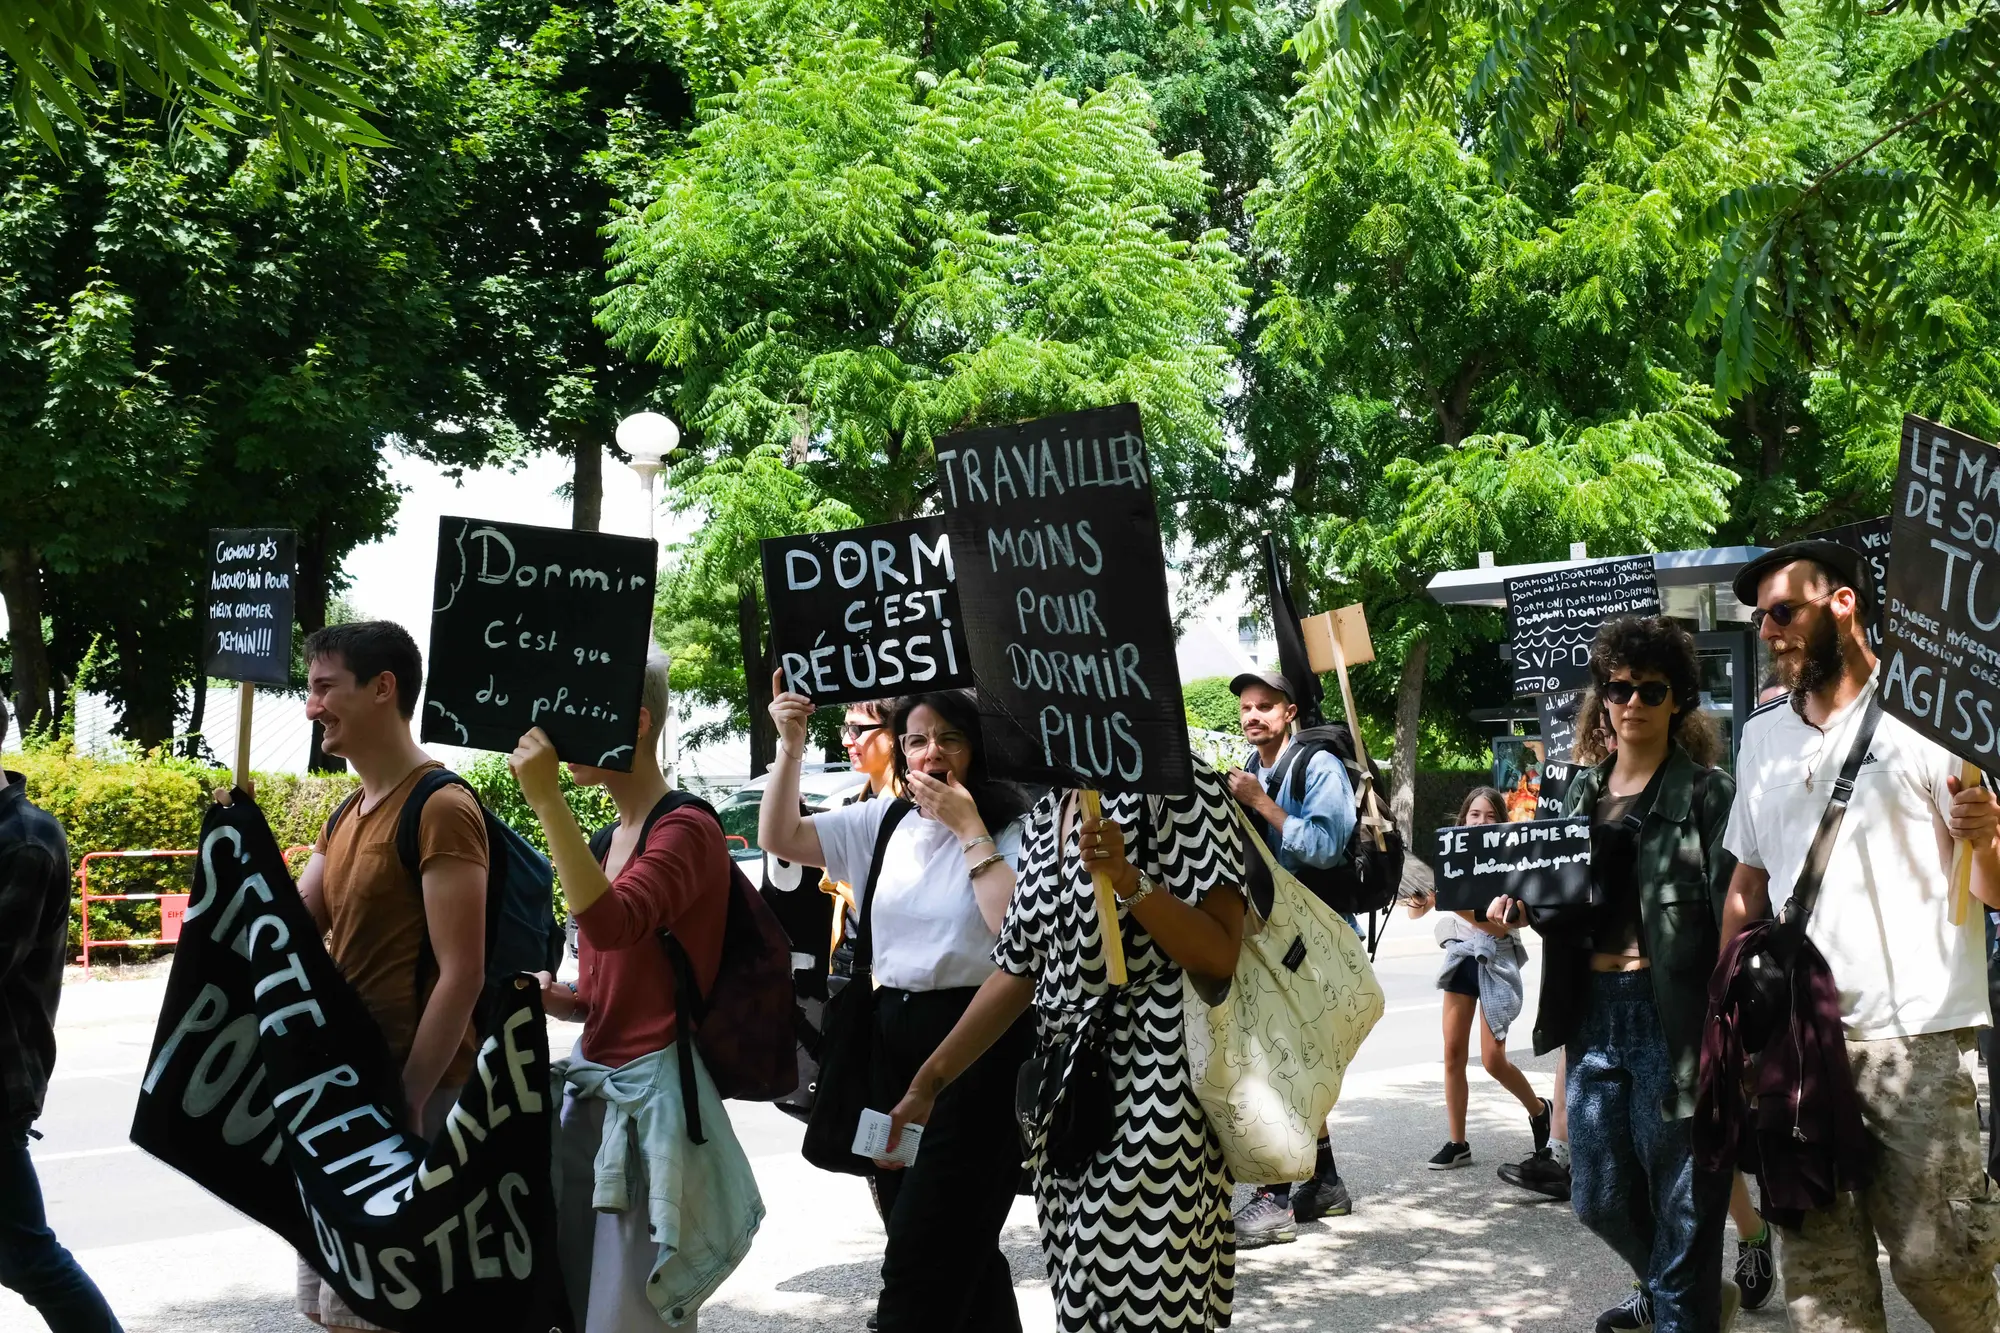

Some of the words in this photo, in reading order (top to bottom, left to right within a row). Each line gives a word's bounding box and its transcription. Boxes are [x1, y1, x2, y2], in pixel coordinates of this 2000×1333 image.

[1910, 427, 1950, 485] LE
[1905, 480, 1946, 529] DE
[471, 526, 647, 592] Dormir
[786, 533, 955, 591] DORM
[1862, 531, 1893, 549] VEU
[265, 571, 289, 589] POUR
[1510, 573, 1559, 591] DORMONS
[1561, 565, 1609, 580] DORMONS
[1512, 583, 1560, 602] DORMONS
[1561, 577, 1616, 590] DORMONS
[844, 588, 947, 633] C'EST
[1016, 586, 1107, 638] POUR
[1513, 597, 1563, 615] DORMONS
[1566, 592, 1612, 607] DORMONS
[1517, 610, 1564, 626] DORMONS
[1567, 602, 1629, 618] DORMONS
[485, 613, 557, 652] C'est
[574, 645, 610, 665] que
[476, 674, 508, 706] du
[533, 687, 618, 722] plaisir
[1040, 705, 1144, 782] PLUS
[1545, 764, 1568, 781] OUI
[1438, 831, 1470, 856] JE
